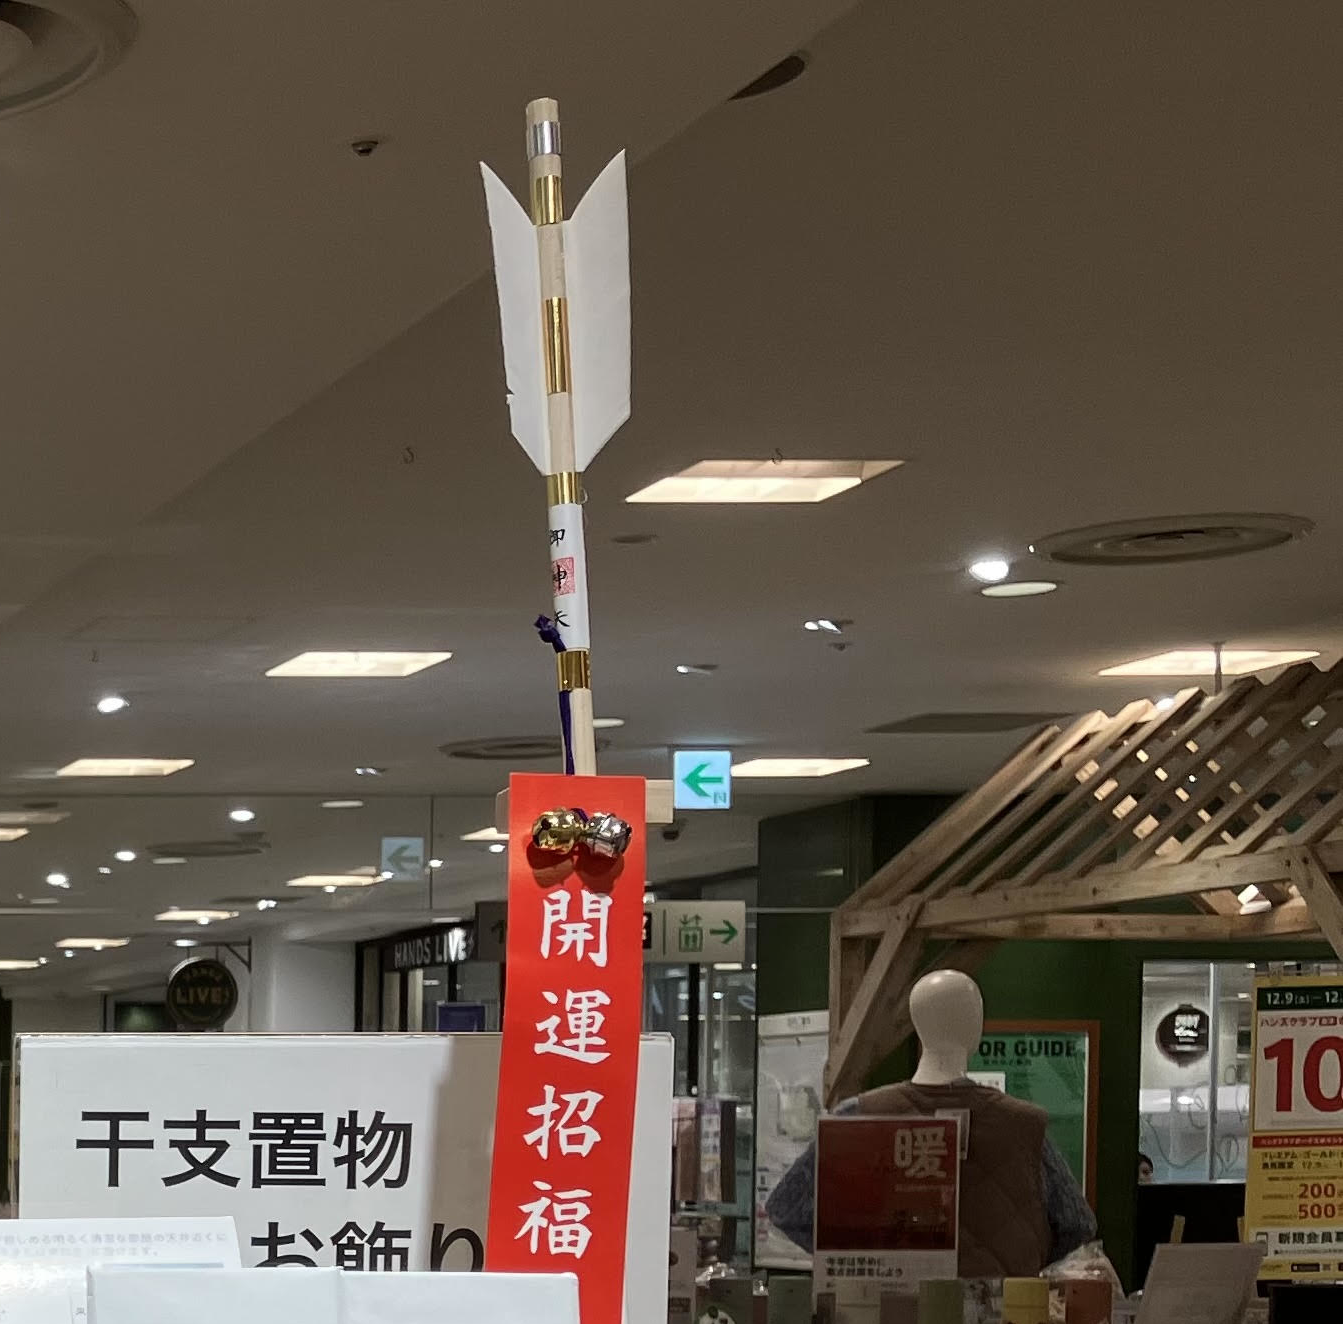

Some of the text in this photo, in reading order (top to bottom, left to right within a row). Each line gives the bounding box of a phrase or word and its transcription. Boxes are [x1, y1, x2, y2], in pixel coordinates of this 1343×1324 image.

[515, 889, 613, 1260] 開運招福
[1014, 1040, 1079, 1057] GUIDE
[76, 1109, 413, 1190] 干支置物
[894, 1127, 947, 1179] 暖
